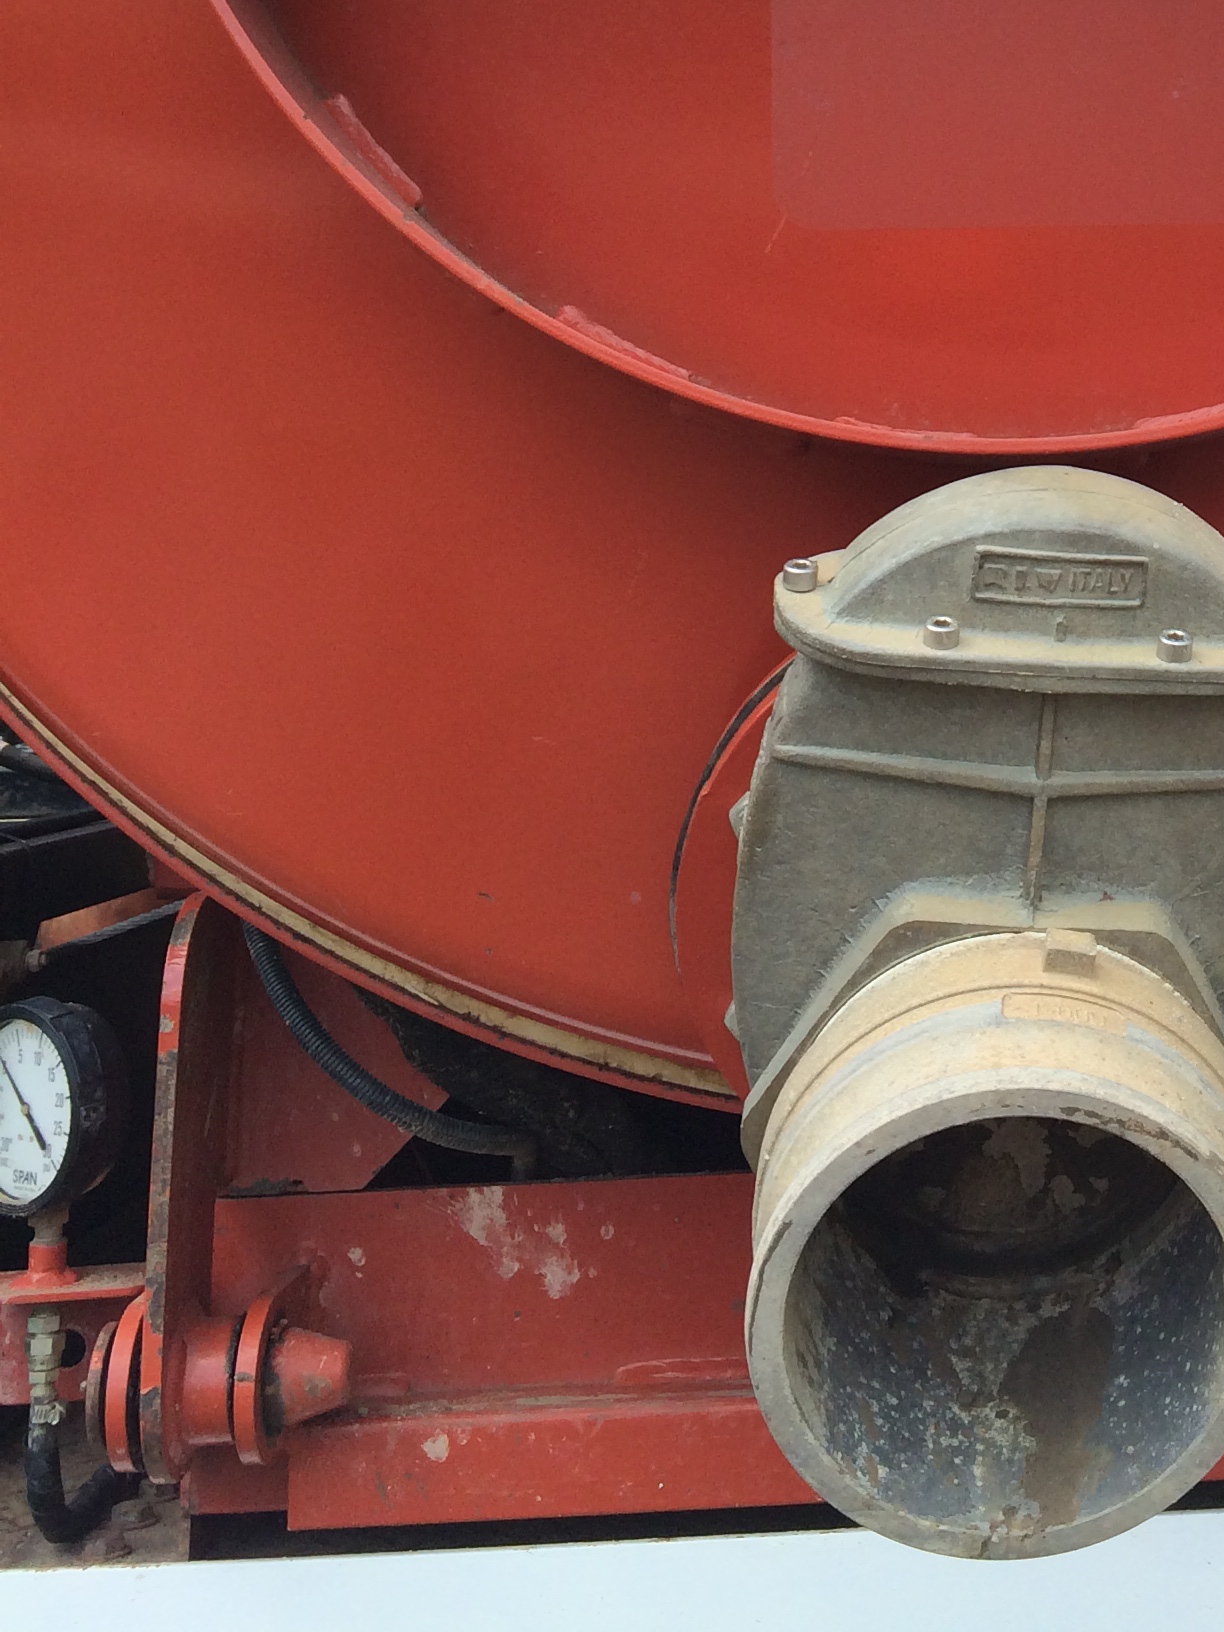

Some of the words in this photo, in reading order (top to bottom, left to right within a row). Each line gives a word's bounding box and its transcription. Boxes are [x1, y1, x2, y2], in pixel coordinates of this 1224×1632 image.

[1069, 567, 1135, 595] ITALY
[17, 1048, 24, 1064] 5
[34, 1050, 42, 1067] 10
[48, 1067, 56, 1083] 15
[55, 1092, 65, 1109] 20
[53, 1120, 63, 1136] 25
[12, 1169, 38, 1186] SPAN
